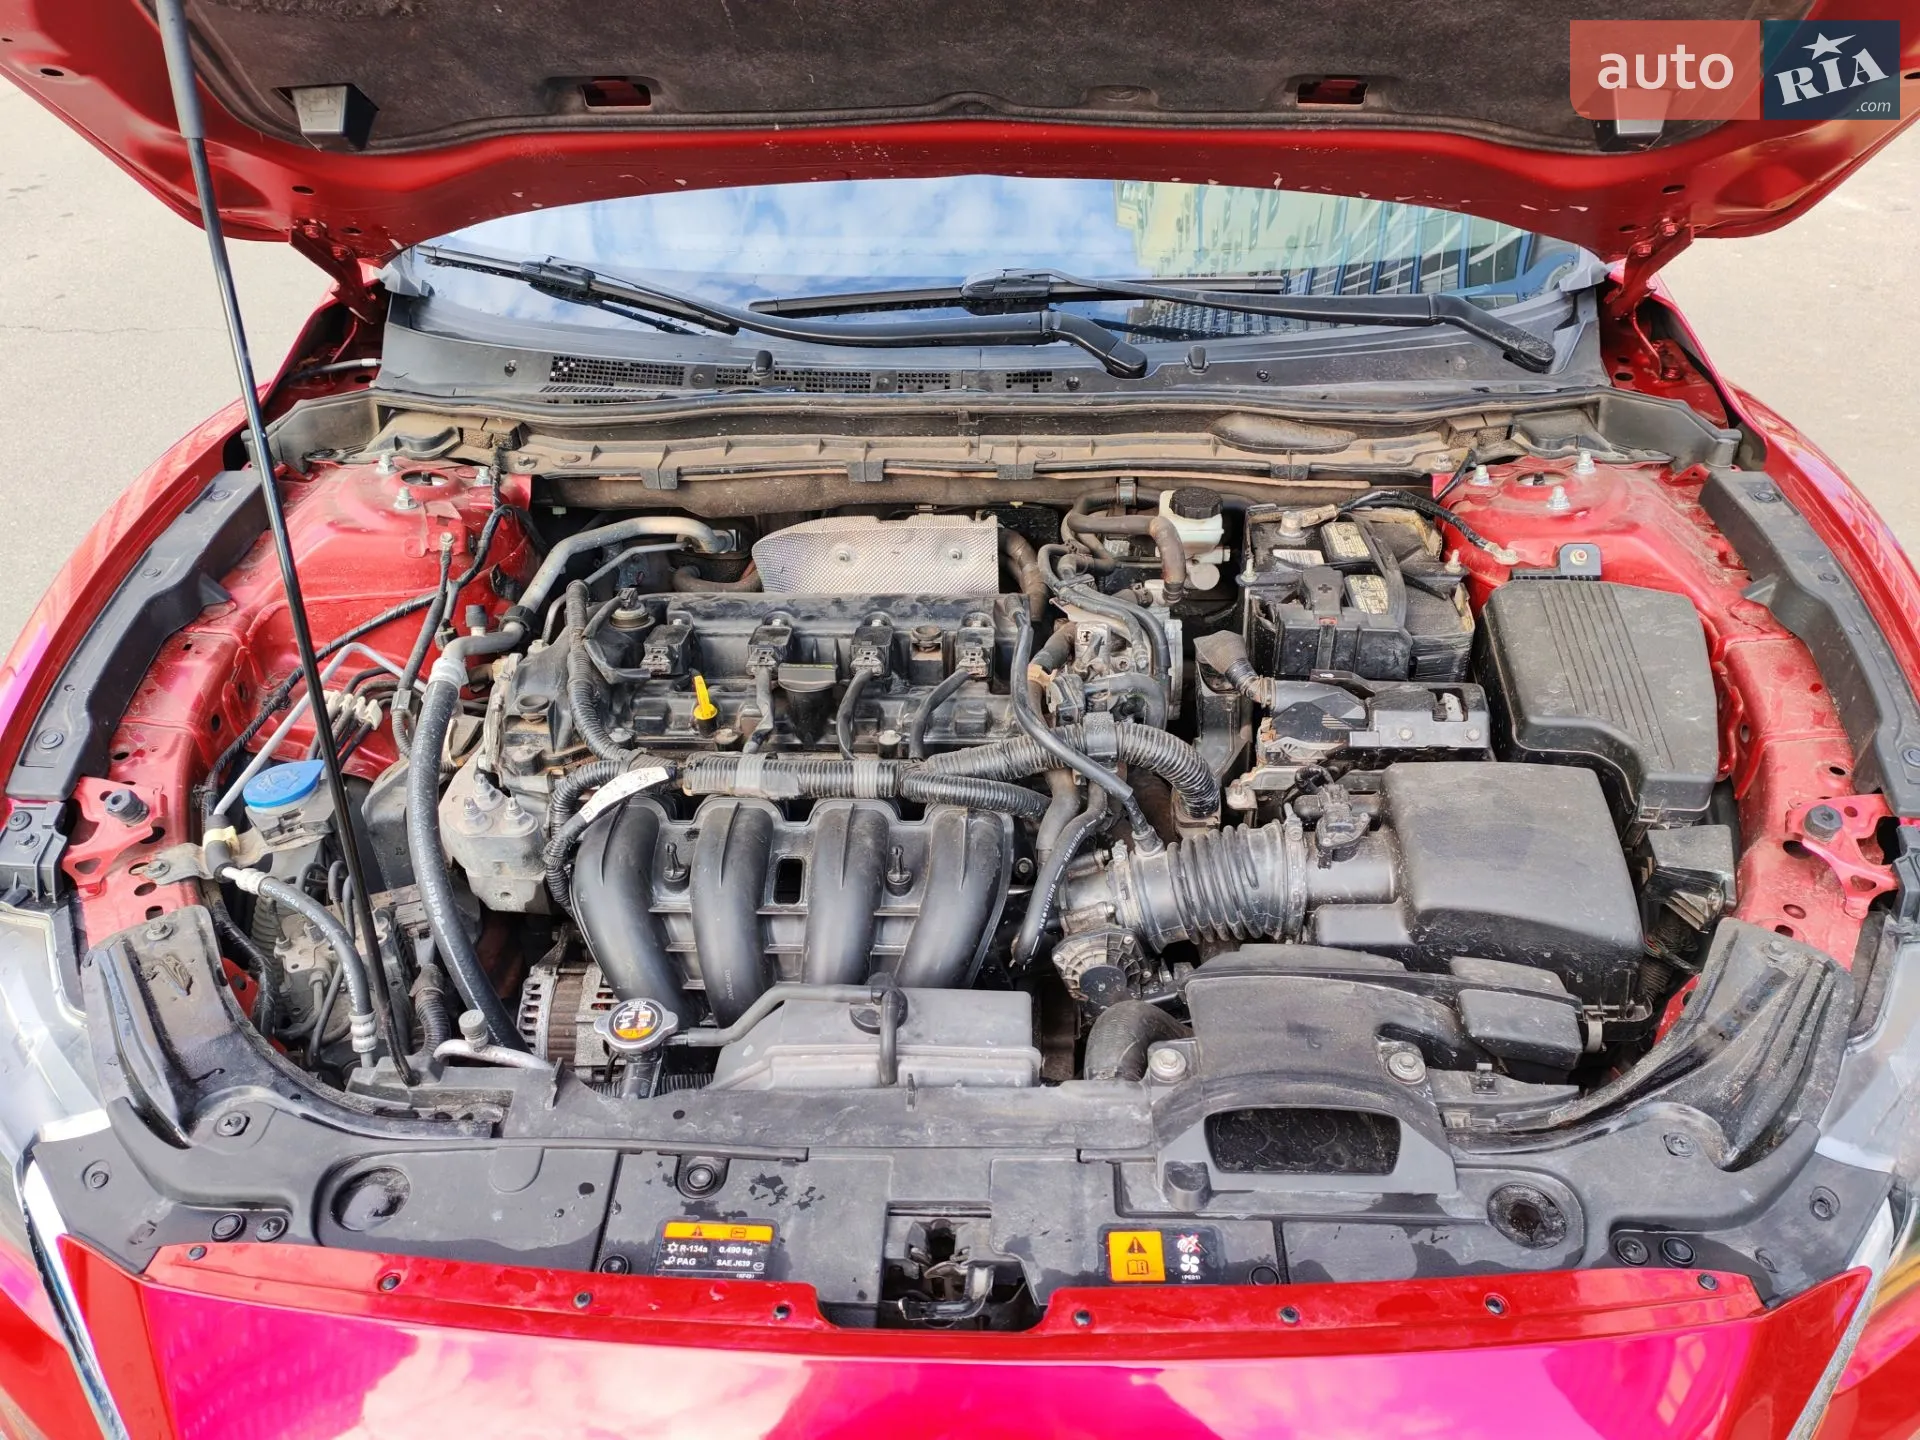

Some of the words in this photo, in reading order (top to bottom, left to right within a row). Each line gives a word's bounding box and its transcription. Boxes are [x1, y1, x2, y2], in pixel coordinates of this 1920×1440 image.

[680, 1244, 708, 1253] R-134a
[742, 1247, 754, 1256] kg
[676, 1258, 697, 1266] PAG
[716, 1259, 732, 1267] SAE
